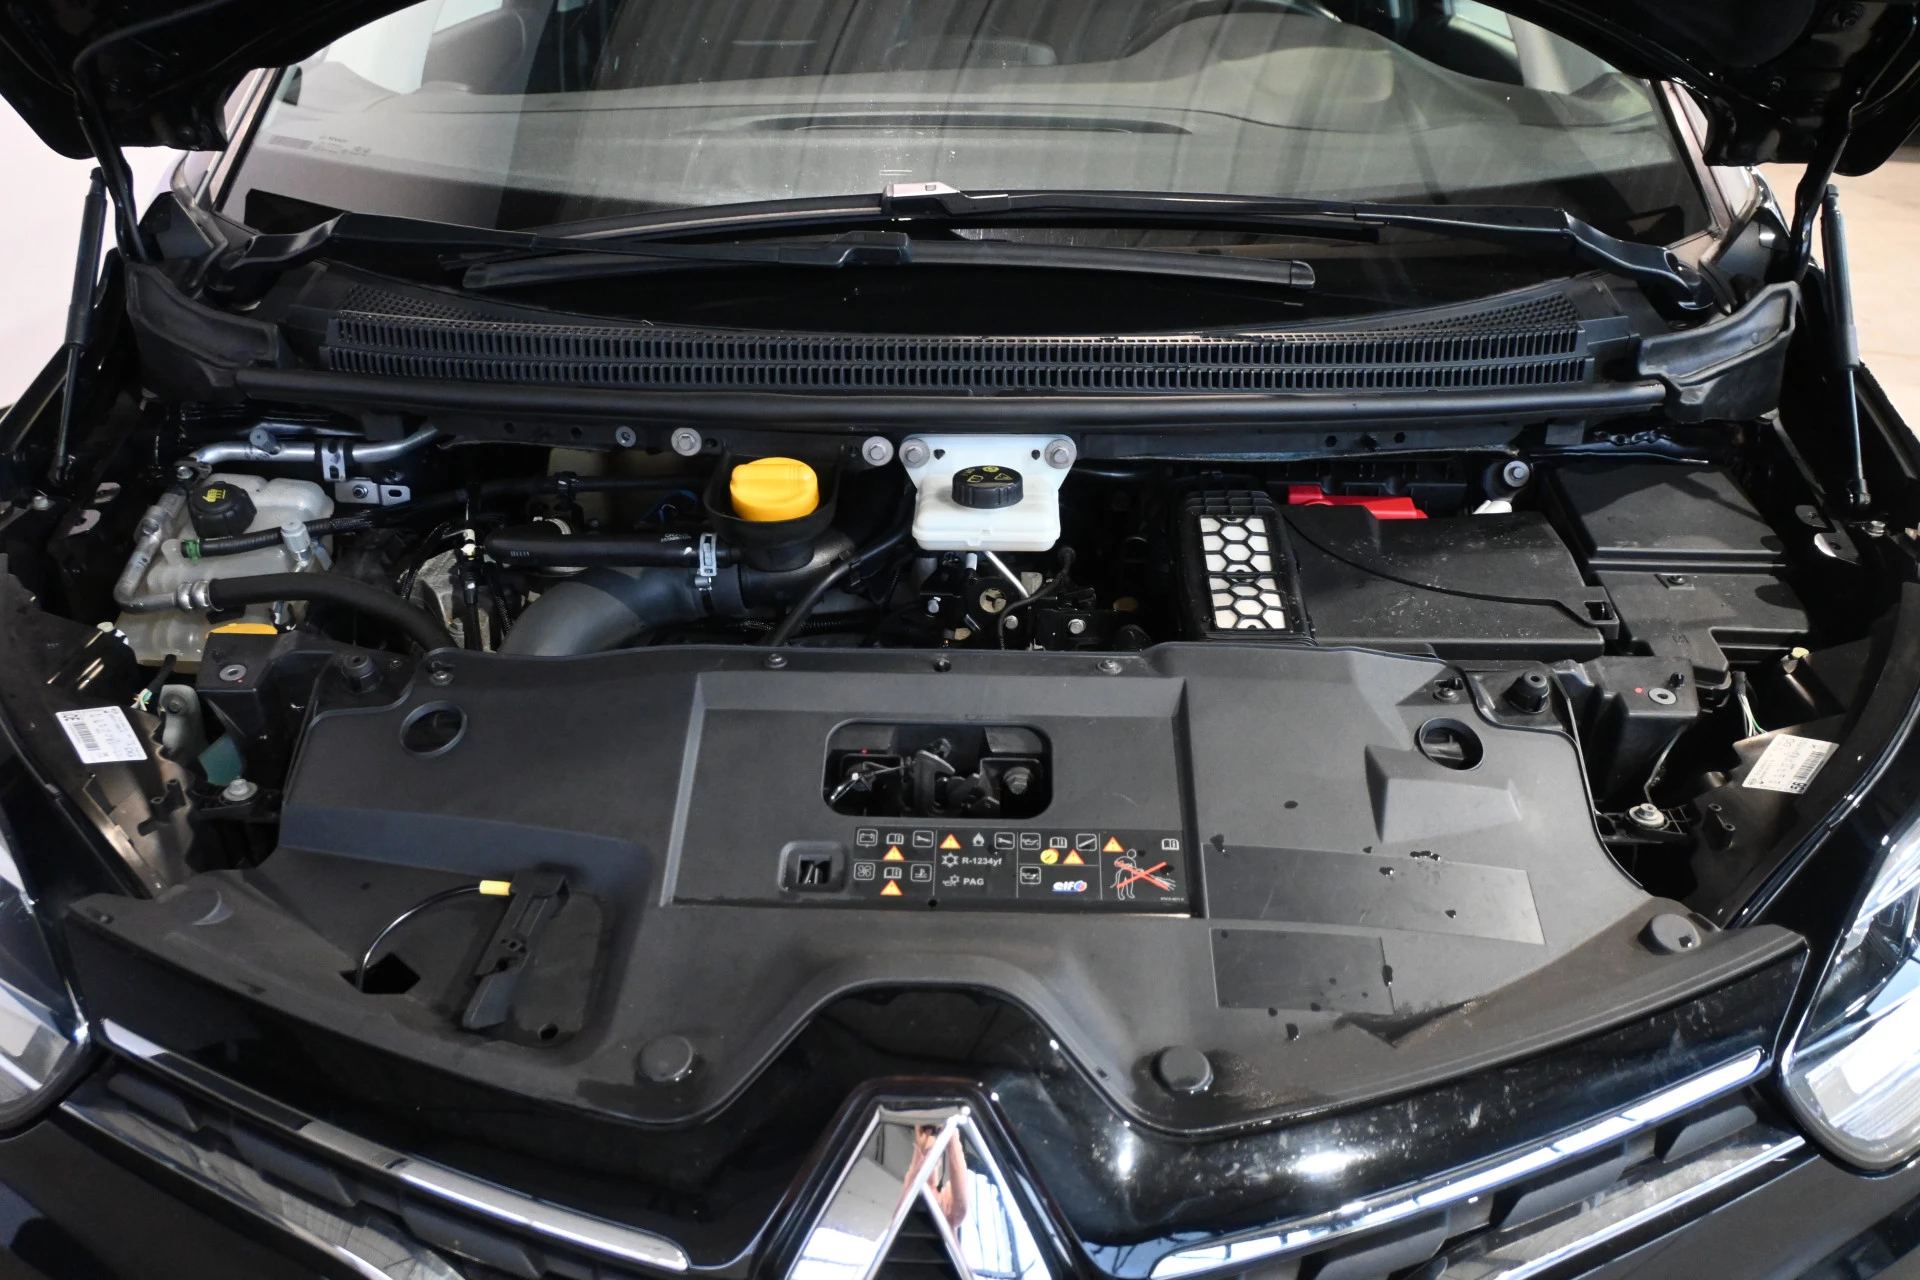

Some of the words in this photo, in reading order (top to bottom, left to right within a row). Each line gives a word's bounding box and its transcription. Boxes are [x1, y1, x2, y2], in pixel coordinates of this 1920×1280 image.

[962, 856, 1003, 867] R-1234yf
[963, 877, 985, 886] PAG
[1053, 881, 1076, 891] elf
